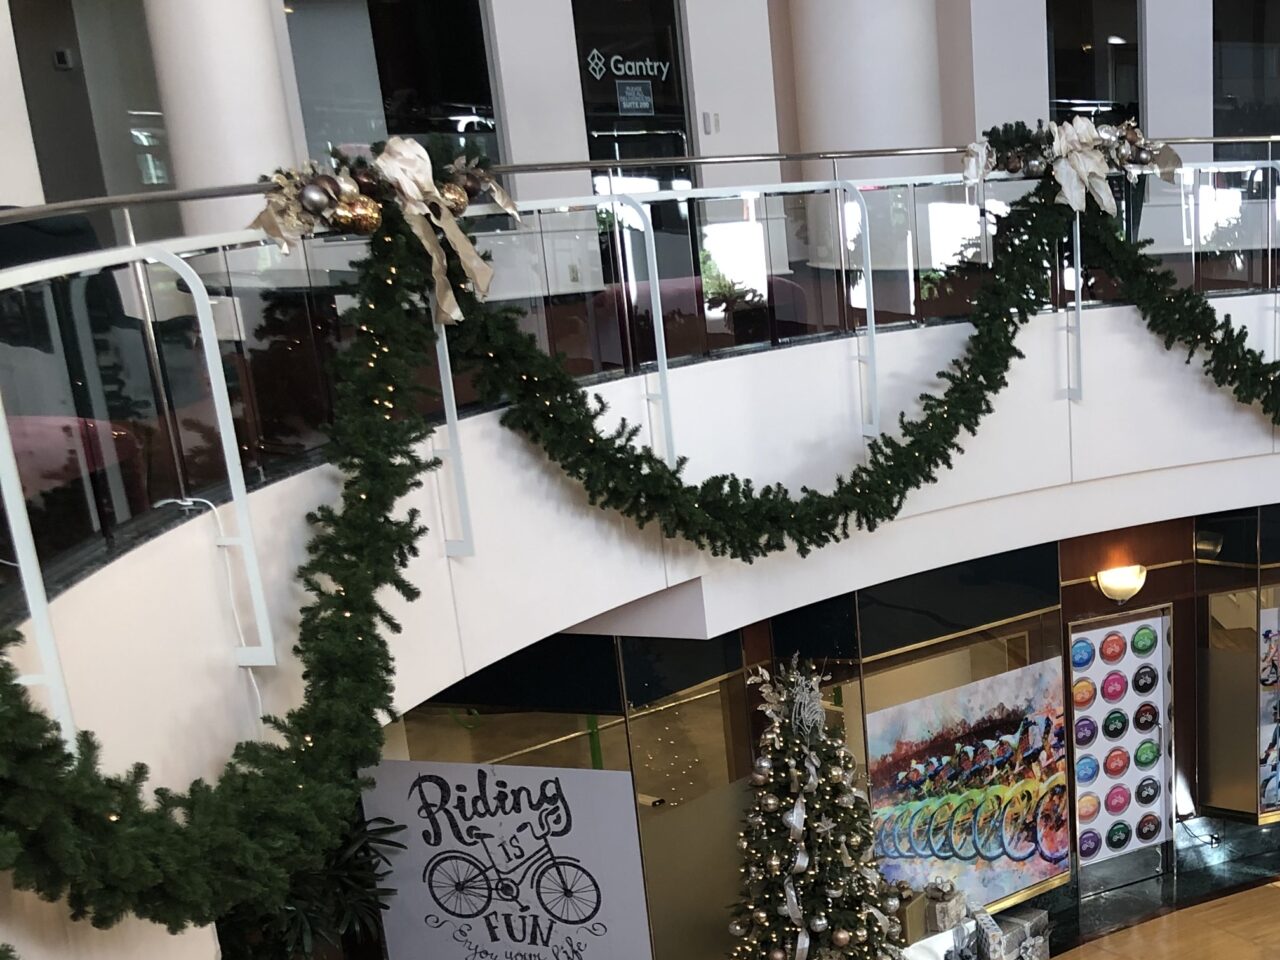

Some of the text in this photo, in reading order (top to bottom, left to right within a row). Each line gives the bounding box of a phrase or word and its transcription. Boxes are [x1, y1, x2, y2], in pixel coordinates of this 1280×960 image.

[610, 55, 670, 81] Gantry
[623, 101, 639, 109] SUITE
[408, 769, 572, 846] Riding
[498, 834, 524, 863] IS
[483, 911, 555, 947] FUN
